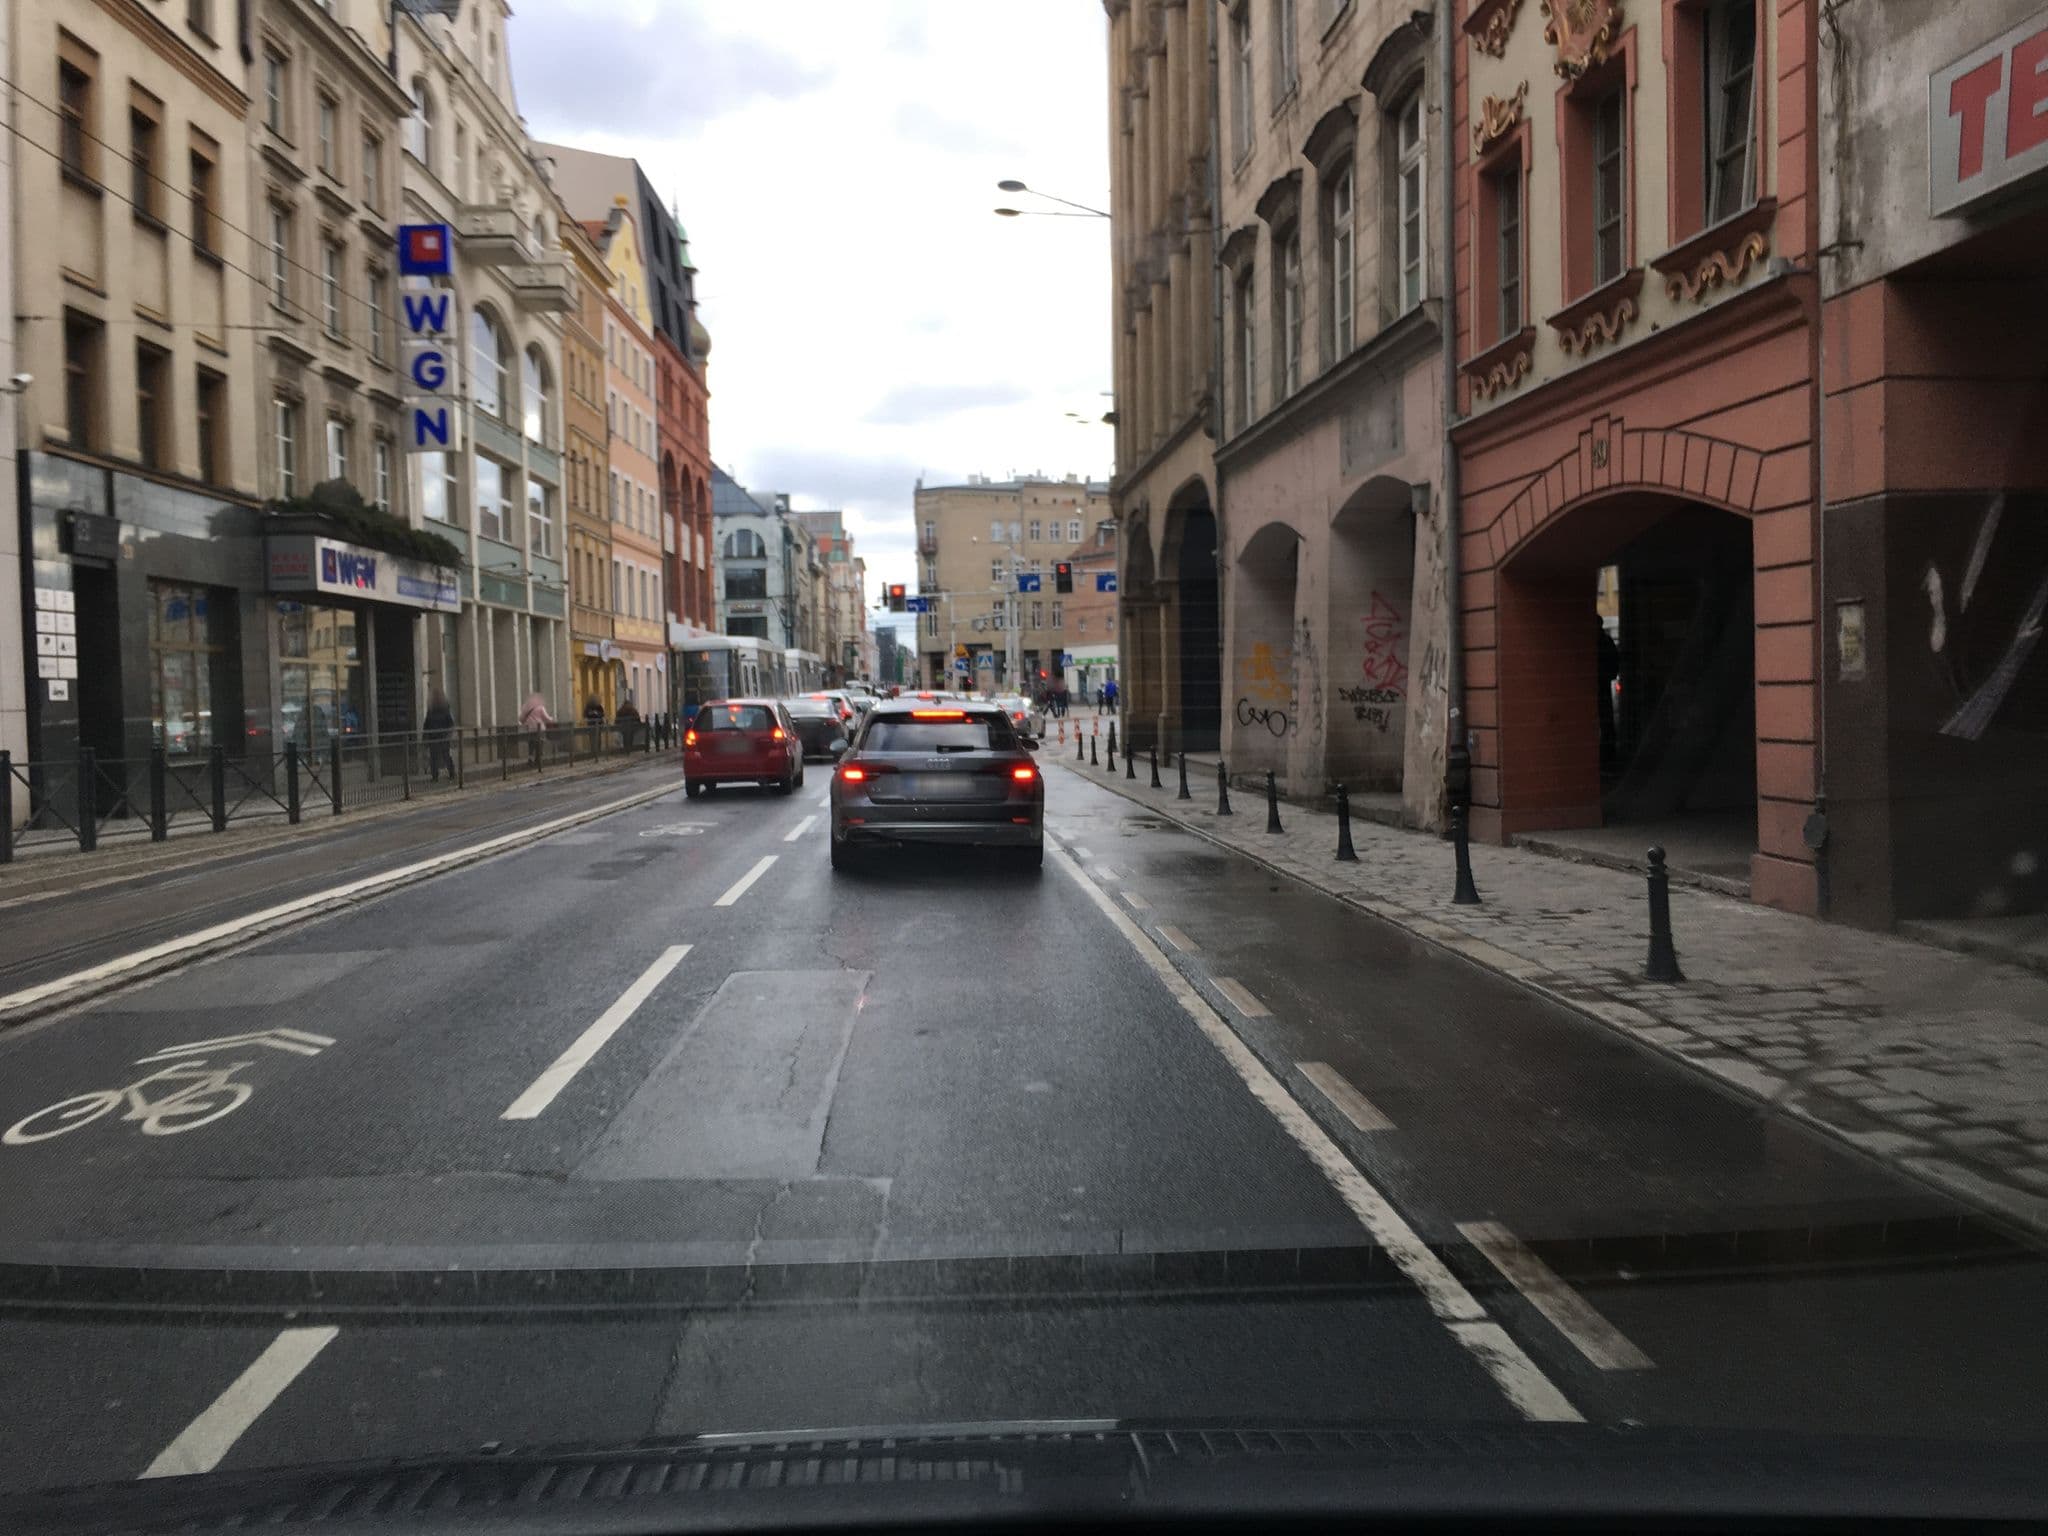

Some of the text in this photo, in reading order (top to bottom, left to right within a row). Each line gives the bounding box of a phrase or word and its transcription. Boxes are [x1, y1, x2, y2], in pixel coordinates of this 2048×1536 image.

[1949, 29, 2048, 182] TE
[404, 295, 449, 445] WGN
[338, 552, 376, 591] WGN
